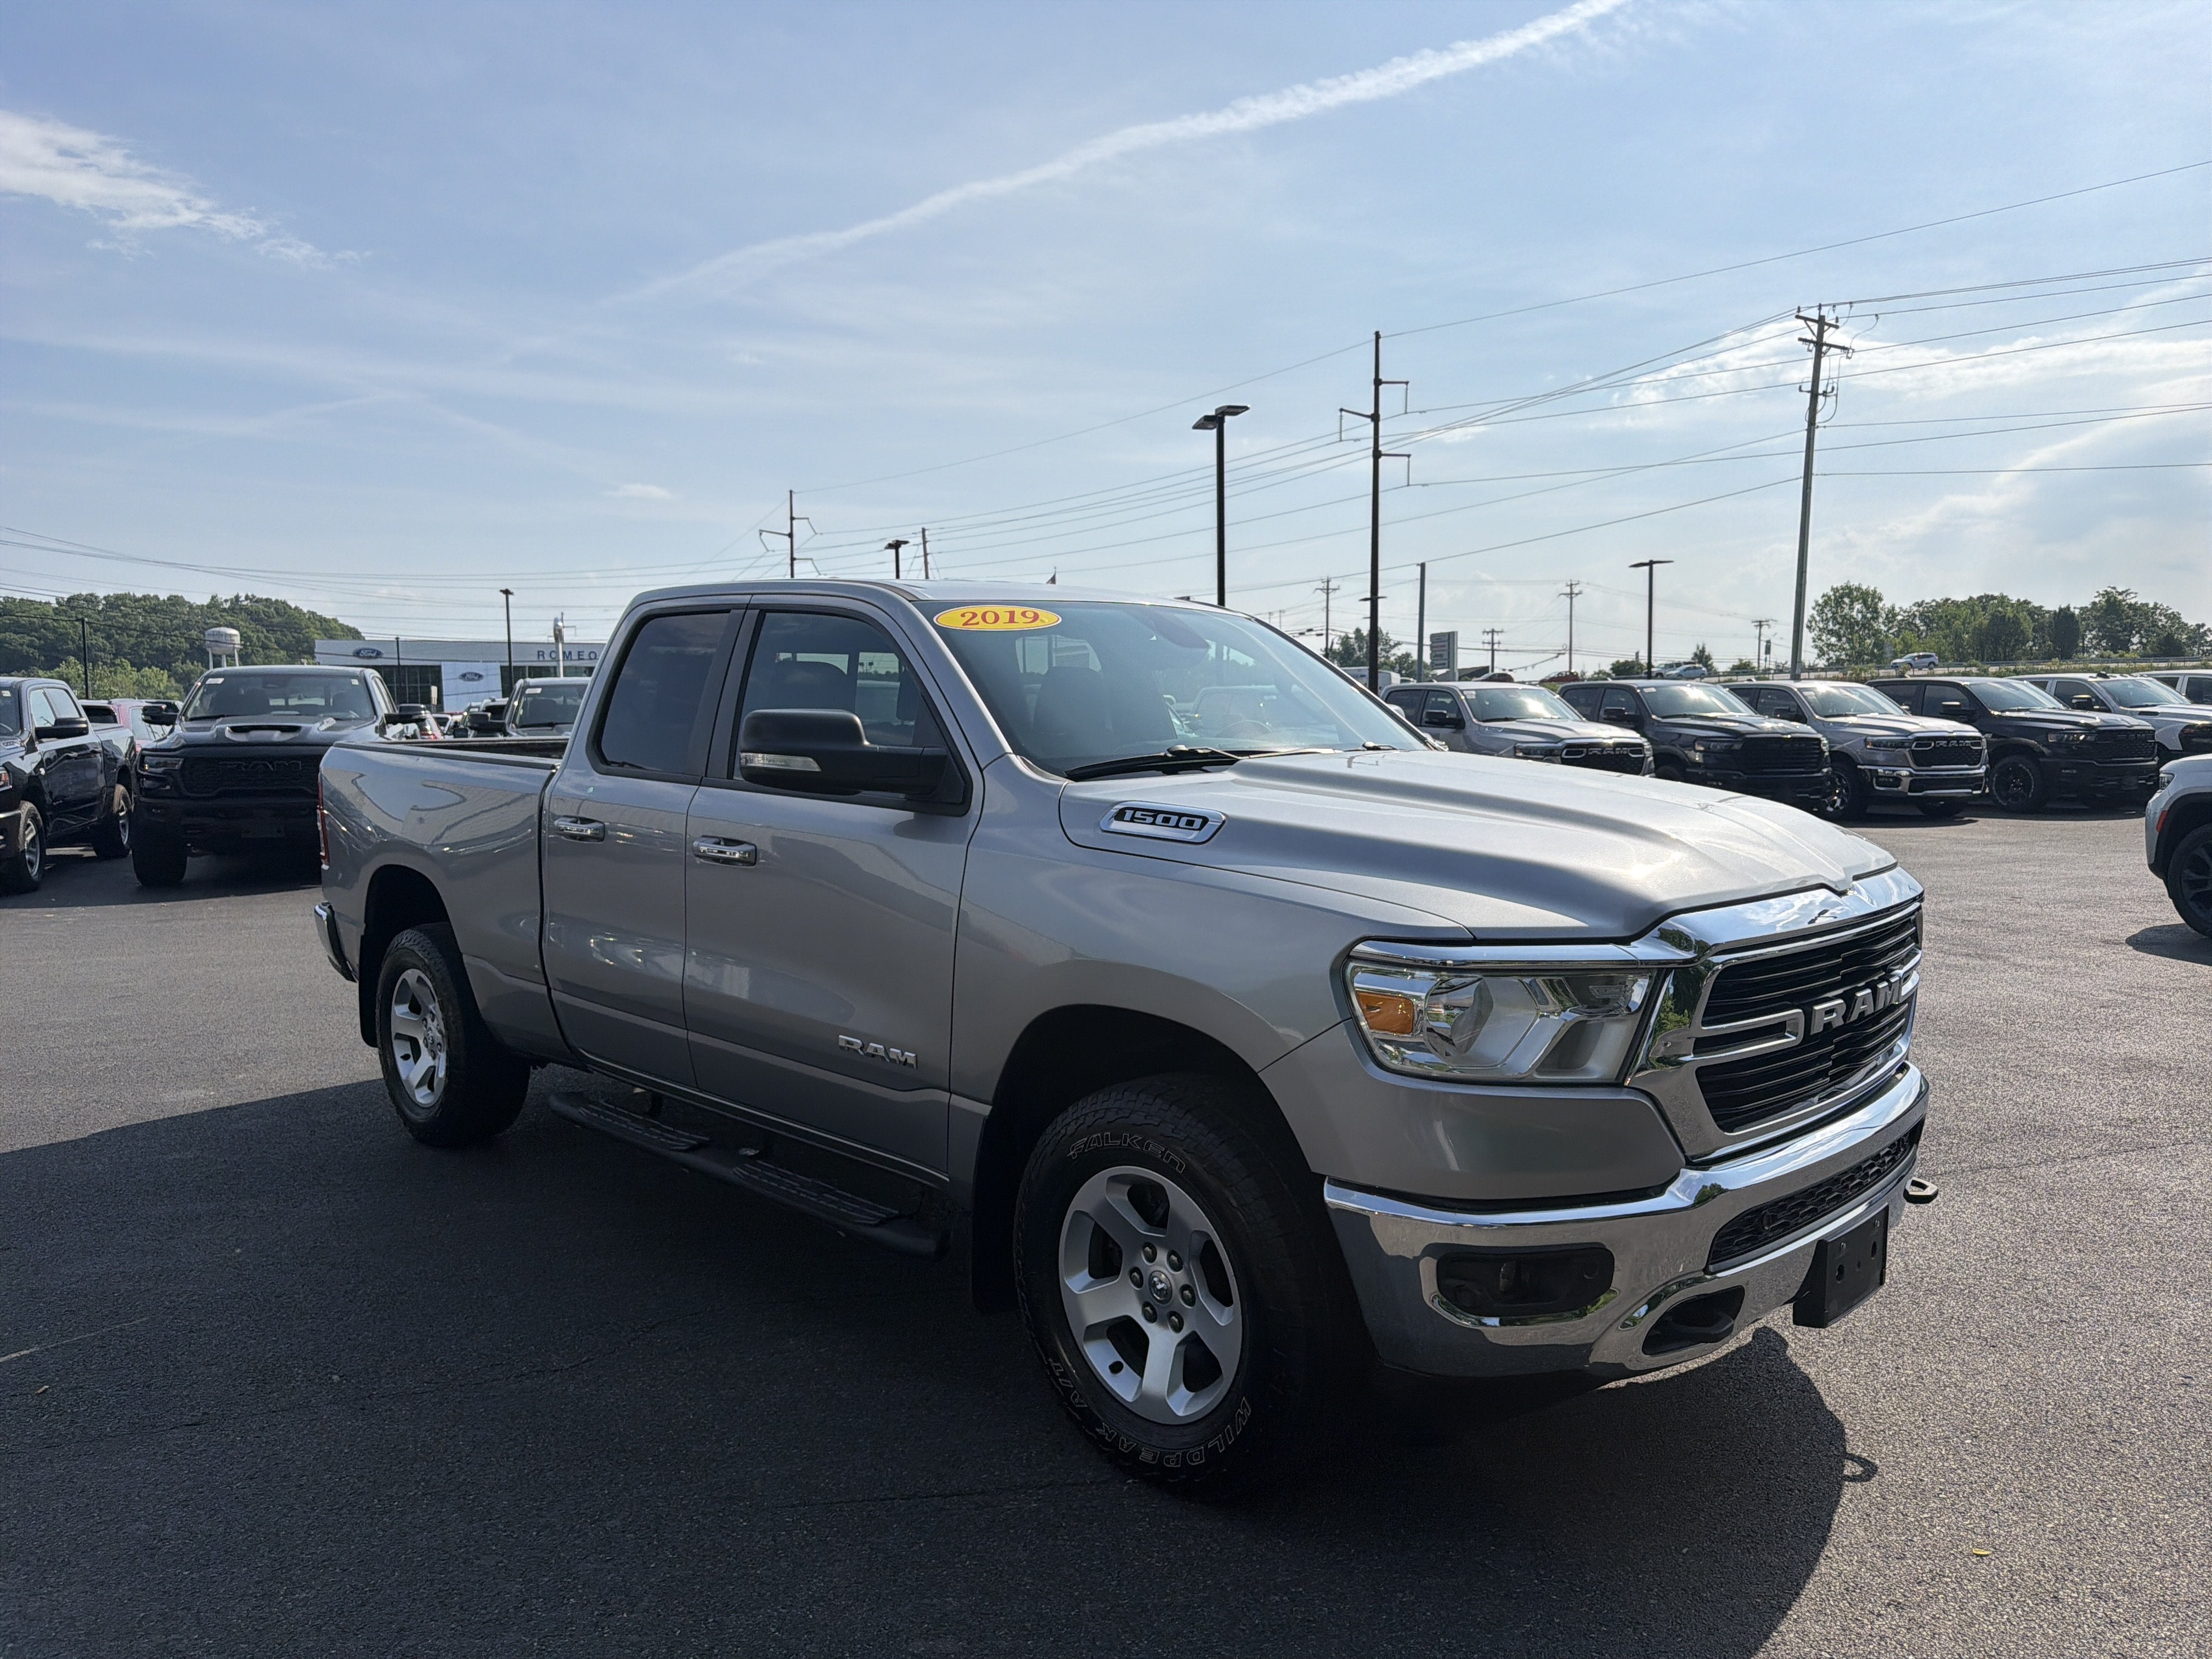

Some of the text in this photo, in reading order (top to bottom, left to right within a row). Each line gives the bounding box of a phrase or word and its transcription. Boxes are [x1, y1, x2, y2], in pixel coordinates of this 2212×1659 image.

[960, 610, 1040, 627] 2019
[358, 649, 378, 658] Ford
[537, 650, 597, 661] ROMEO
[1124, 810, 1203, 829] 1500
[1810, 974, 1900, 1036] RAM
[838, 1035, 918, 1069] RAM
[1065, 1132, 1187, 1175] FALKEN
[1095, 1396, 1252, 1468] WILDPEAK
